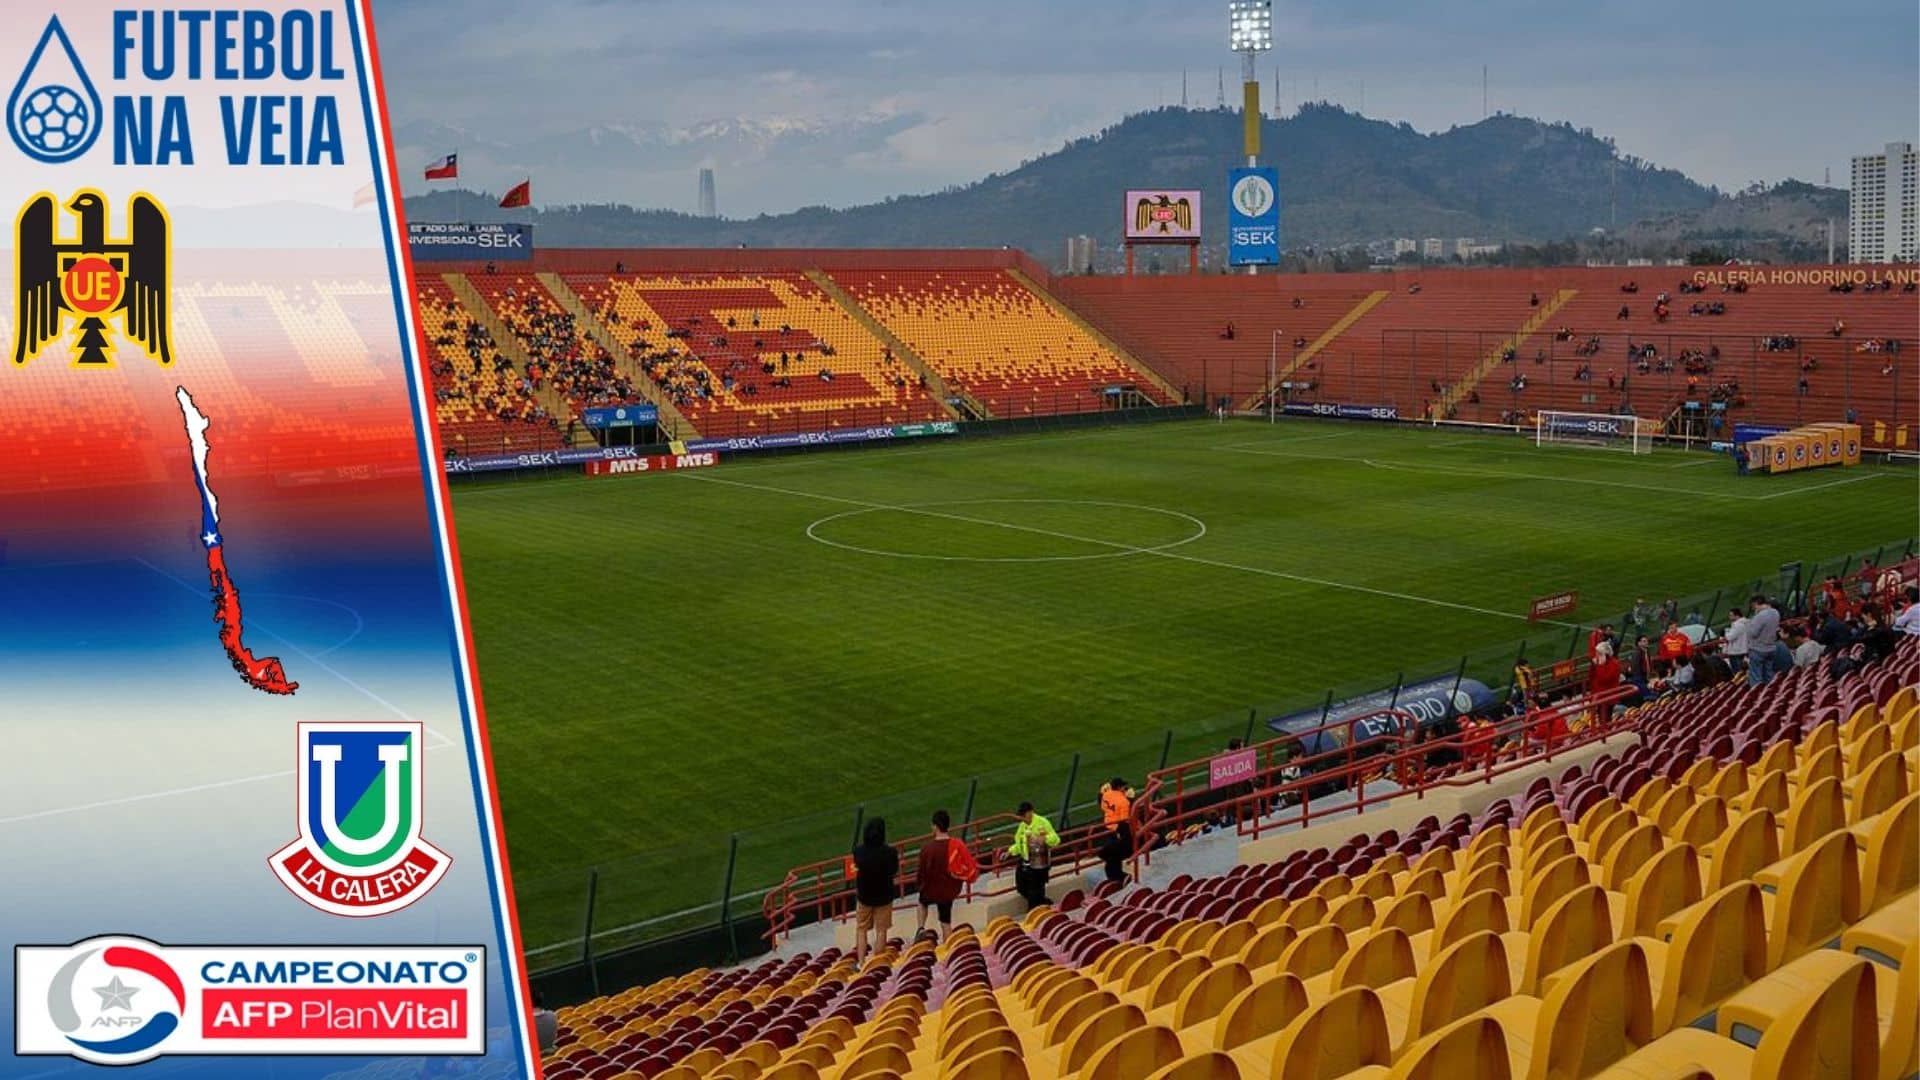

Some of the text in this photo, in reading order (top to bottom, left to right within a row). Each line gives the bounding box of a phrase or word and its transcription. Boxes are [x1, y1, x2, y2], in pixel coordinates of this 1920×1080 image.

[448, 225, 475, 233] SANT
[479, 233, 522, 248] SEK
[1238, 231, 1276, 246] SEK
[1771, 269, 1867, 285] HONORINO
[1313, 403, 1336, 416] SEK
[1371, 408, 1397, 418] SEK
[1587, 420, 1618, 433] SEK
[799, 432, 828, 444] SEK
[866, 428, 895, 439] SEK
[727, 437, 758, 450] SEK
[603, 446, 637, 459] SEK
[444, 459, 467, 473] EK
[518, 453, 553, 467] SEK
[610, 458, 649, 473] MTS
[676, 453, 713, 468] MTS
[1213, 759, 1253, 779] SALIDA
